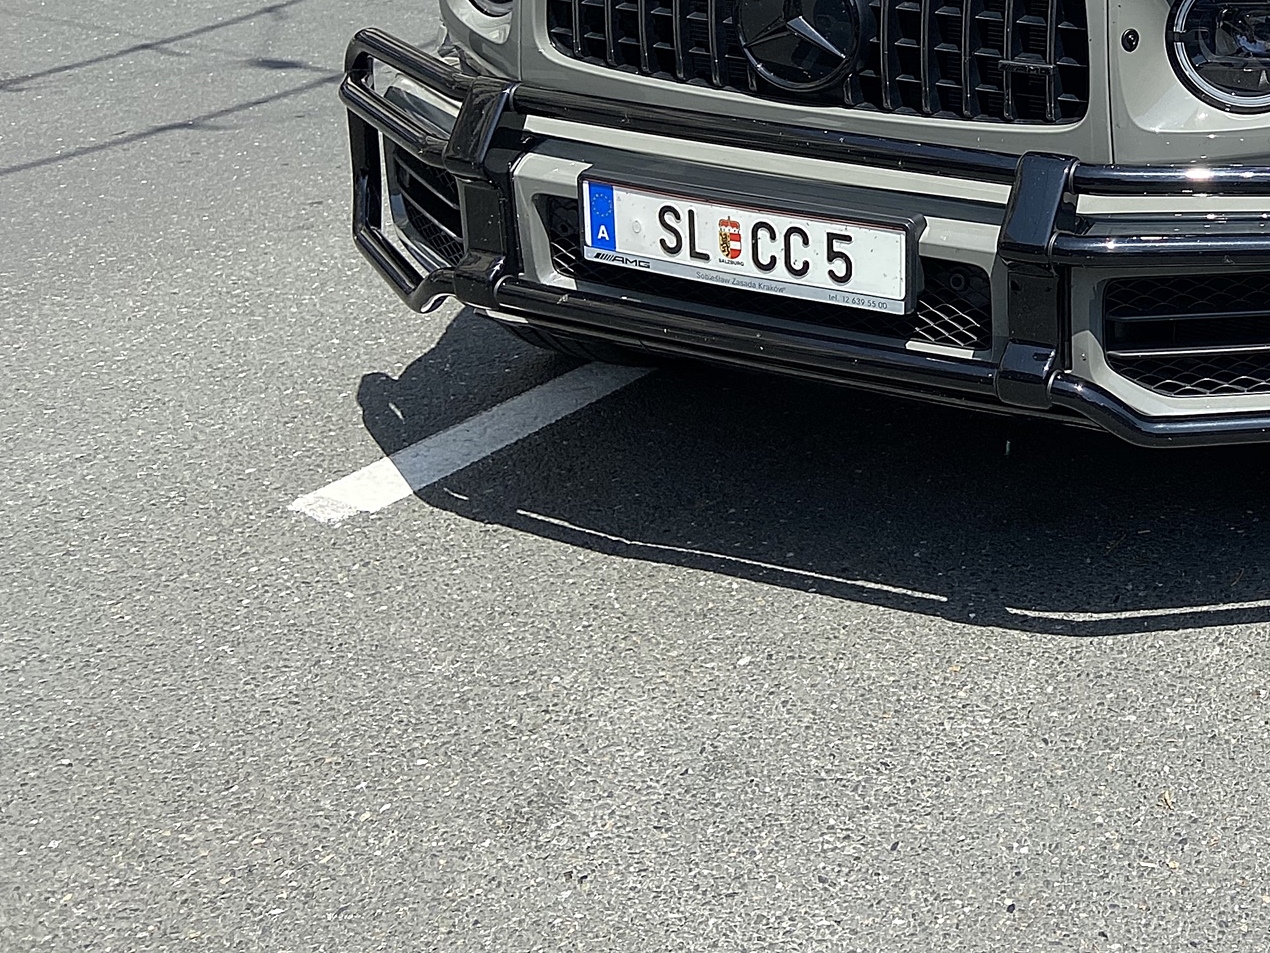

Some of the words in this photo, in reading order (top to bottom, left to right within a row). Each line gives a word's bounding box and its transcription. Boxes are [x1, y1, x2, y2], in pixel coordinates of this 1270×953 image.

[597, 225, 610, 241] A
[657, 205, 711, 262] SL
[751, 221, 811, 277] CC
[827, 233, 852, 284] 5
[611, 256, 651, 269] AMG
[851, 298, 866, 306] 639
[867, 300, 877, 308] 55
[878, 302, 888, 310] 00
